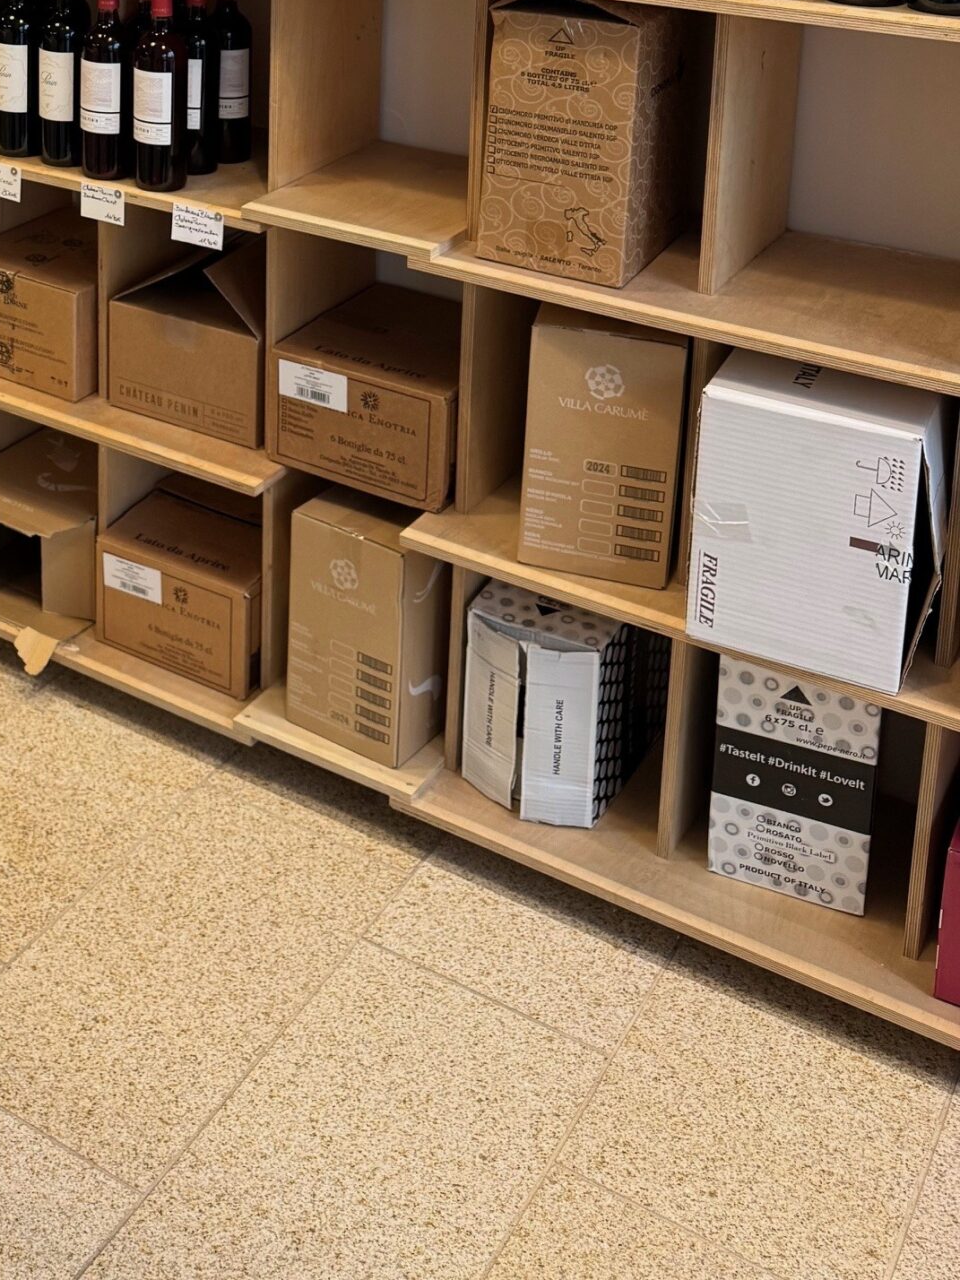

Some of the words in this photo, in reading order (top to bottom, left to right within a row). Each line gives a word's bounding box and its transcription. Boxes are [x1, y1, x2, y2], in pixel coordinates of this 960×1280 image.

[544, 51, 576, 60] FRAGILE
[526, 72, 559, 82] BOTTLES
[540, 67, 577, 78] CONTAINS
[527, 78, 550, 88] TOTAL
[564, 84, 590, 93] LITERS
[534, 112, 564, 123] PRIMITIVO
[497, 138, 529, 149] OTTOCENTO
[167, 399, 199, 418] PENIN
[558, 397, 592, 412] VILLA
[594, 402, 649, 421] CARUMÈ
[368, 413, 418, 438] ENOTRIA
[337, 436, 372, 455] Bottiglie
[373, 448, 383, 458] da
[586, 461, 610, 475] 2024
[699, 551, 718, 629] FRAGILE
[555, 699, 565, 721] CARE
[776, 707, 815, 723] FRAGILE
[789, 704, 802, 712] UP
[554, 723, 564, 743] WITH
[796, 736, 866, 760] www.pepe-nero.it
[552, 744, 562, 776] HANDLE
[819, 768, 866, 791] #LoveIt
[765, 827, 802, 843] ROSATO
[766, 818, 802, 834] BIANCO
[747, 831, 784, 847] Primitivo
[785, 841, 808, 854] Black
[809, 848, 832, 861] Label
[764, 846, 795, 861] ROSSO
[763, 855, 805, 873] NOVELLO
[739, 862, 781, 881] PRODUCT
[783, 876, 797, 885] OF
[797, 880, 827, 894] ITALY
